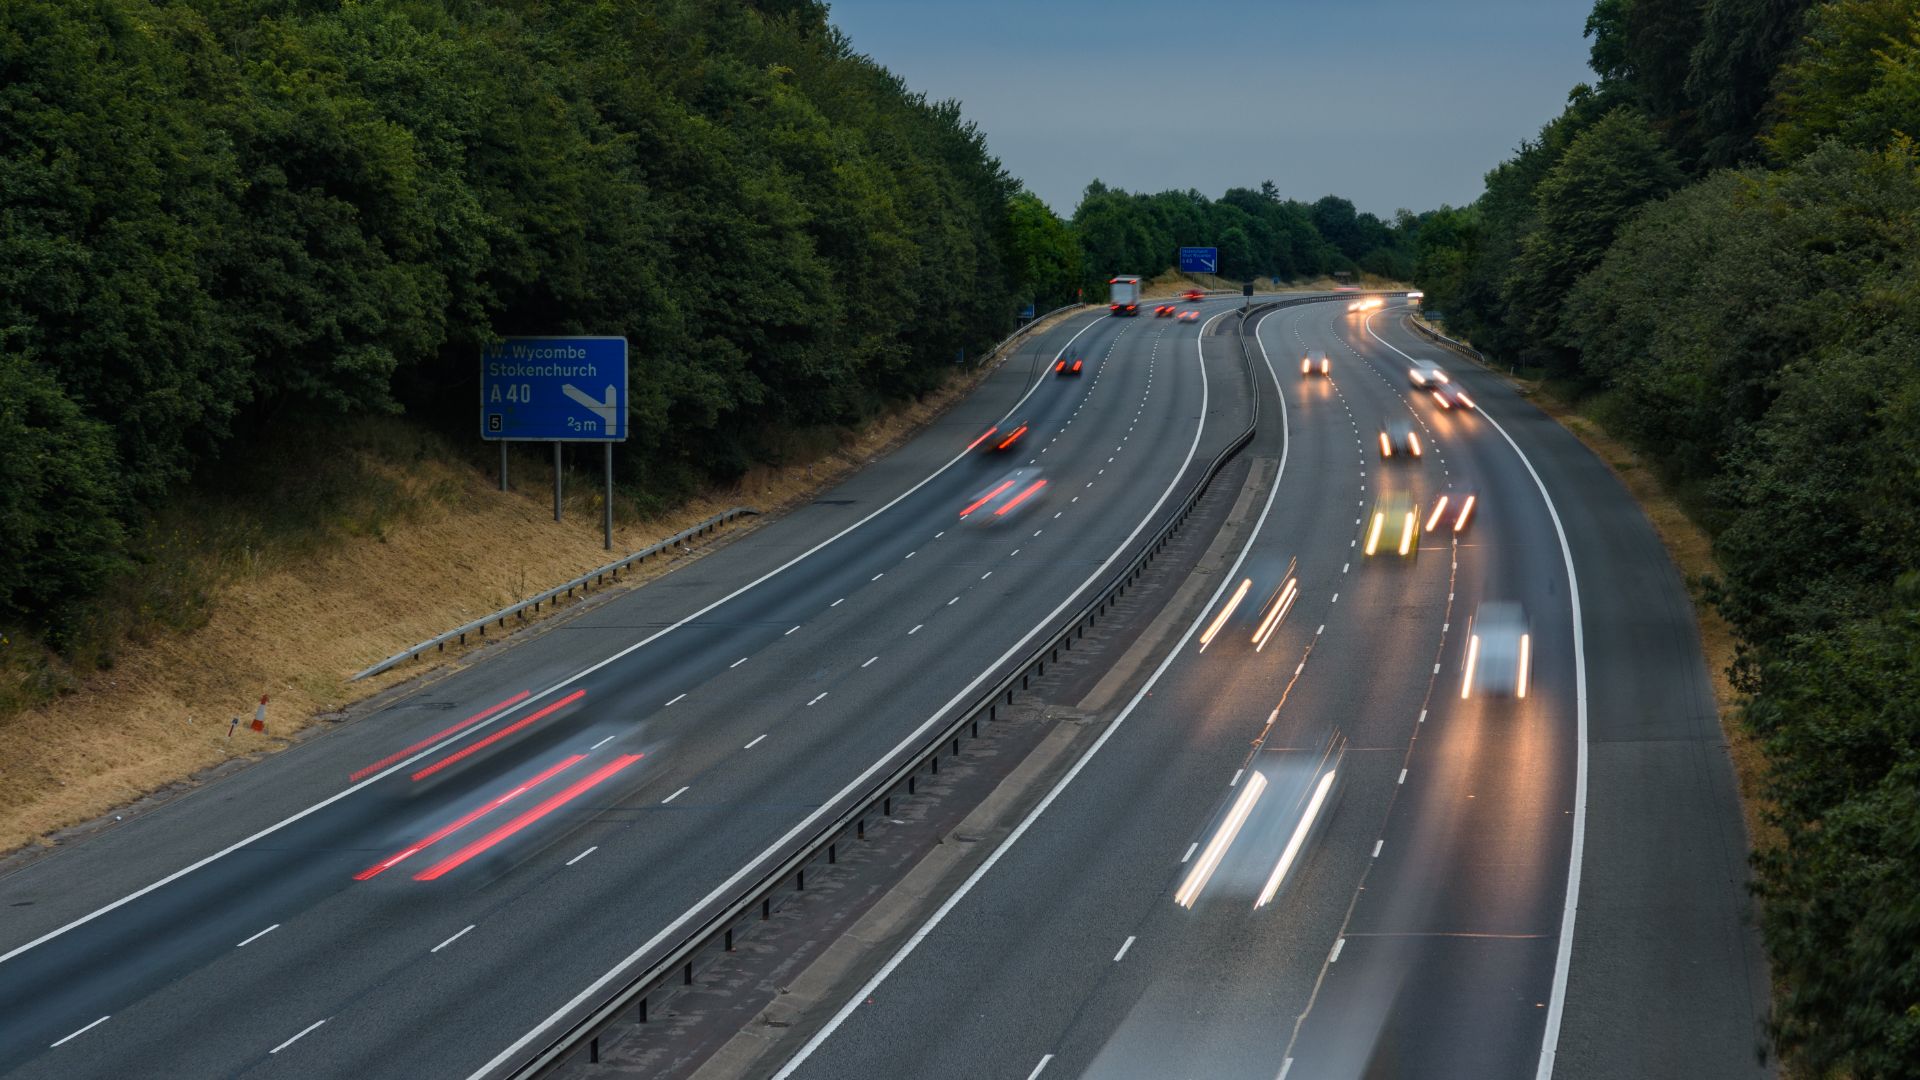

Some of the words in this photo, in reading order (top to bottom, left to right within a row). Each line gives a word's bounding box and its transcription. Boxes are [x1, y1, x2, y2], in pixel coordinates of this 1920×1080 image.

[513, 345, 586, 361] Wycombe
[489, 362, 597, 376] Stokenchurch
[491, 417, 500, 429] 5
